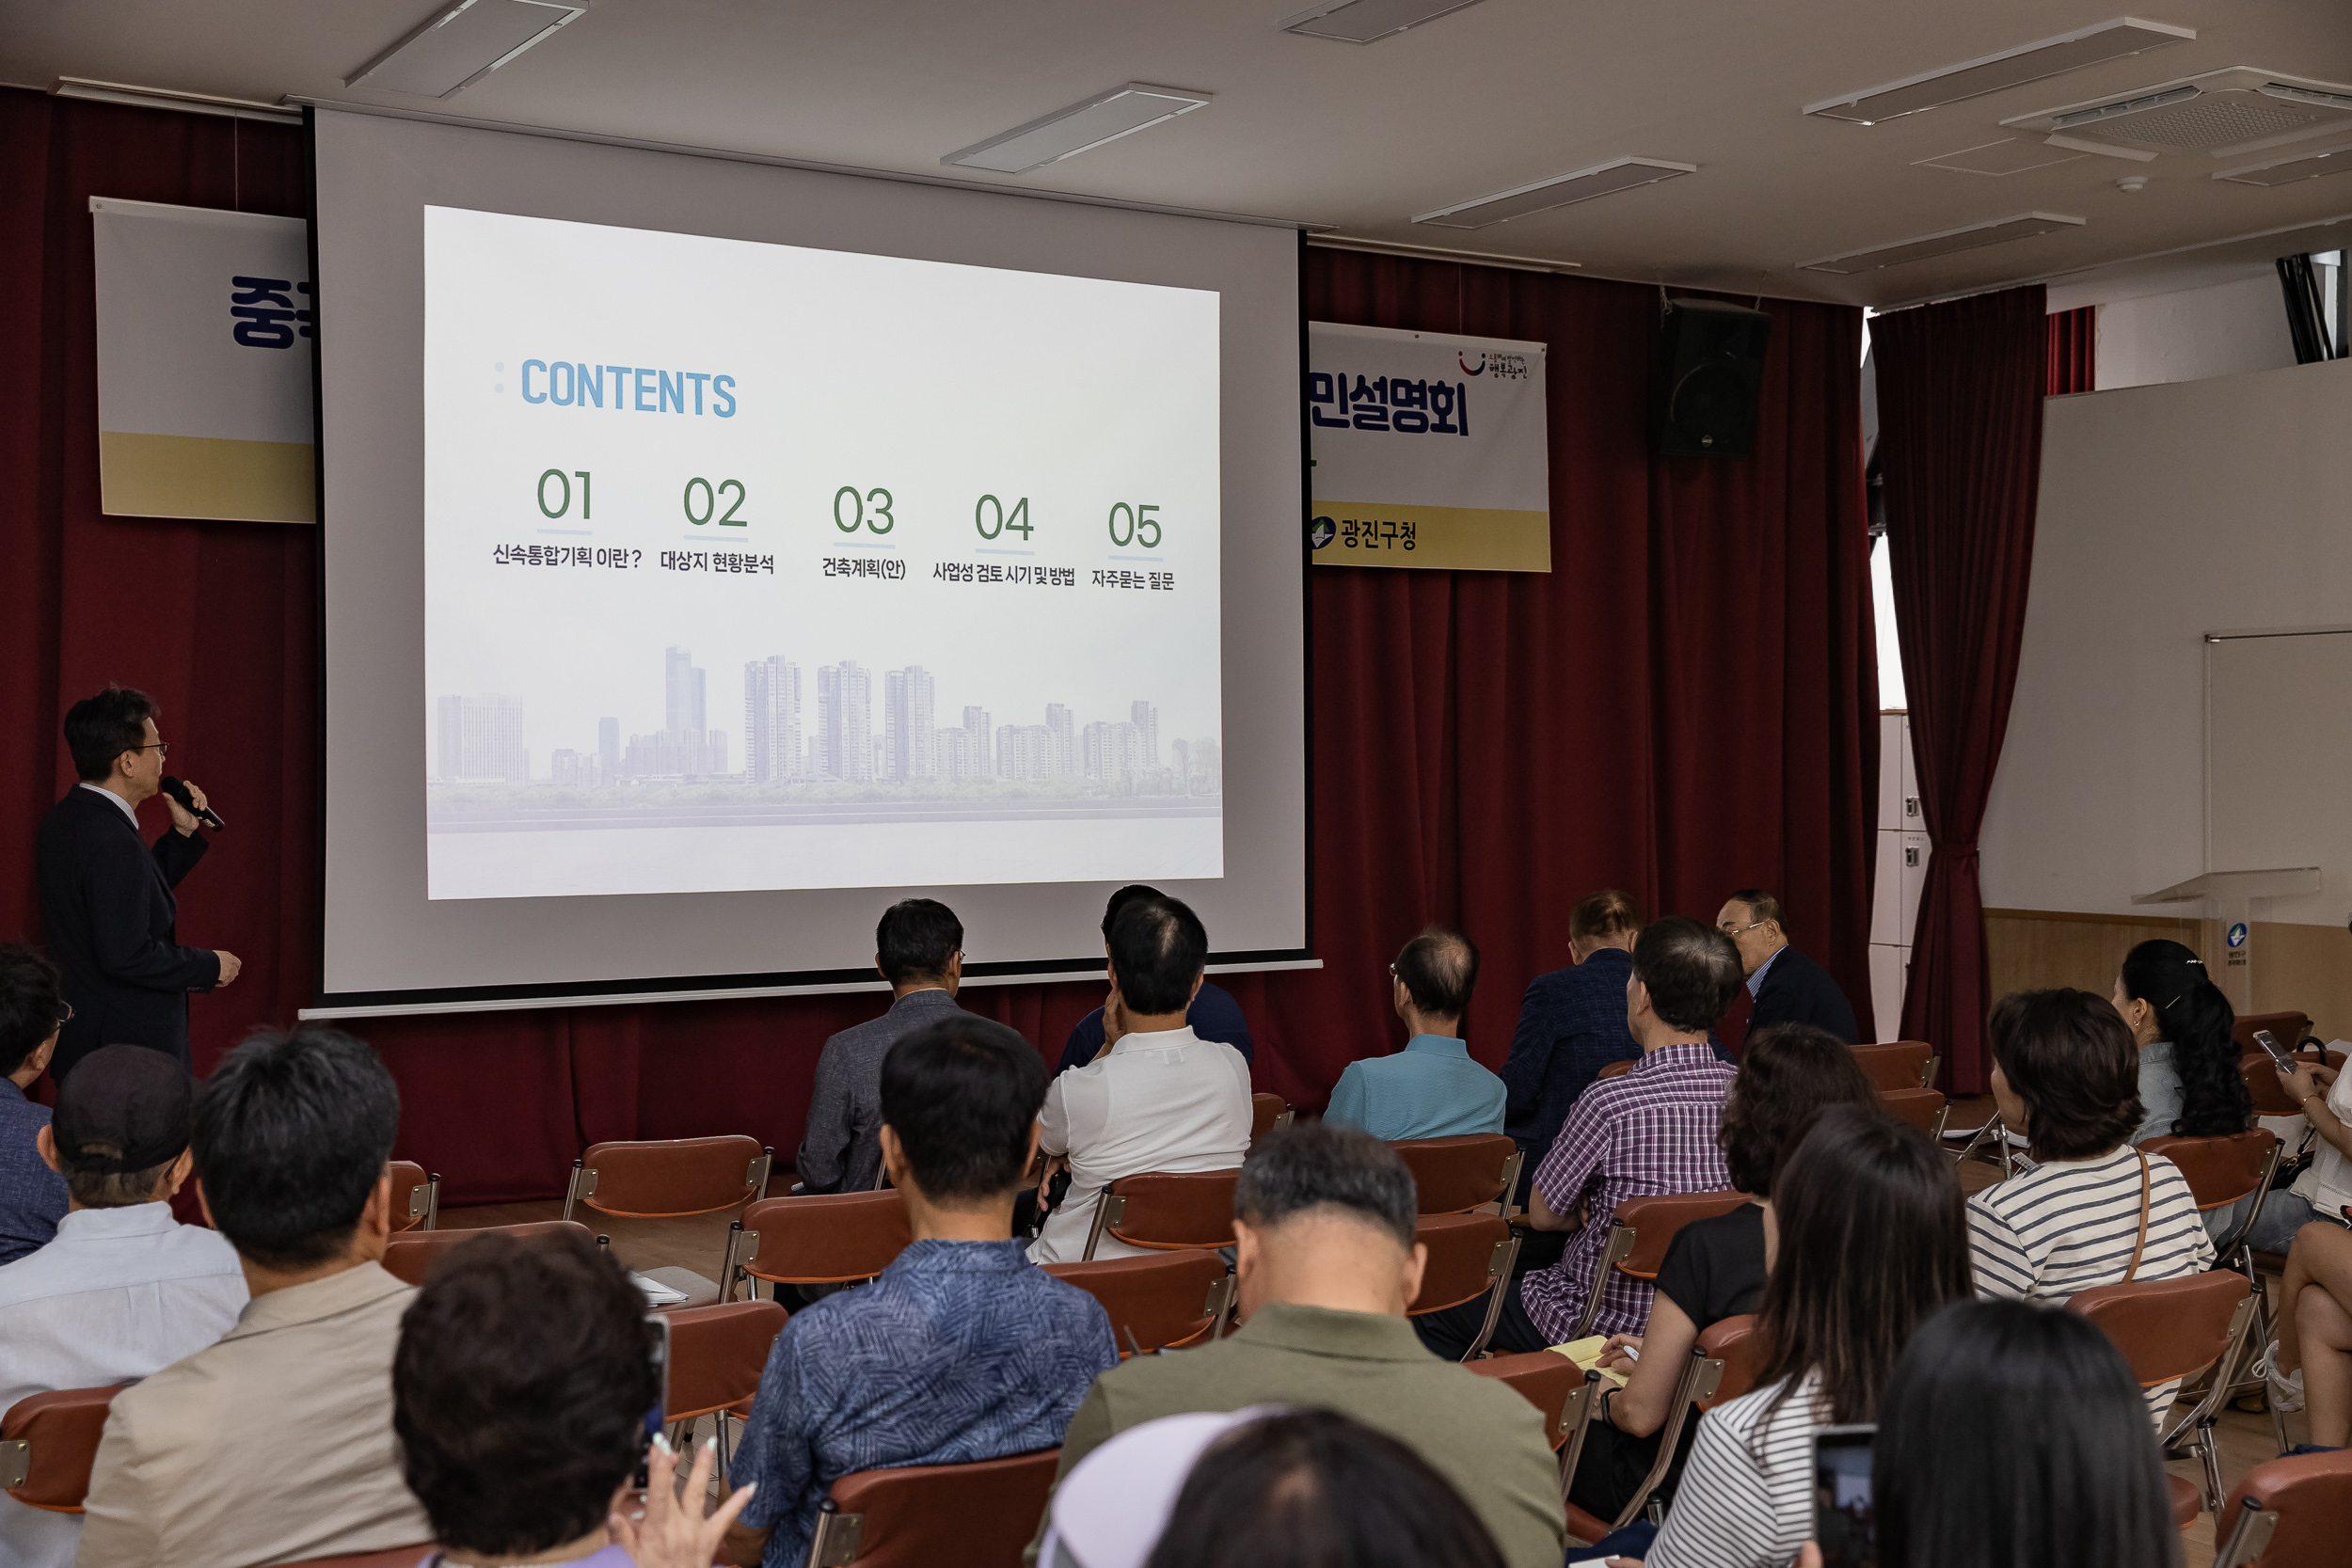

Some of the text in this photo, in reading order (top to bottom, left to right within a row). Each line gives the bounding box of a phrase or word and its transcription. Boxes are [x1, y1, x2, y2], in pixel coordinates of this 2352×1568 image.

[521, 358, 737, 419] CONTENTS
[1488, 362, 1528, 380] 행복광진
[1310, 372, 1470, 436] 민설명회
[537, 468, 591, 520] 01
[683, 477, 748, 528] 02
[834, 485, 895, 535] 03
[975, 494, 1035, 541] 04
[1108, 501, 1162, 548] 05
[1341, 518, 1417, 551] 광진구청
[492, 544, 593, 568] 신속통합기획
[660, 550, 774, 575] 대상지 현황분석
[822, 557, 906, 580] 건축계획(안)
[932, 562, 1075, 587] 사업성 검토 시기 및 방법
[1091, 569, 1175, 591] 자주묻는 질문
